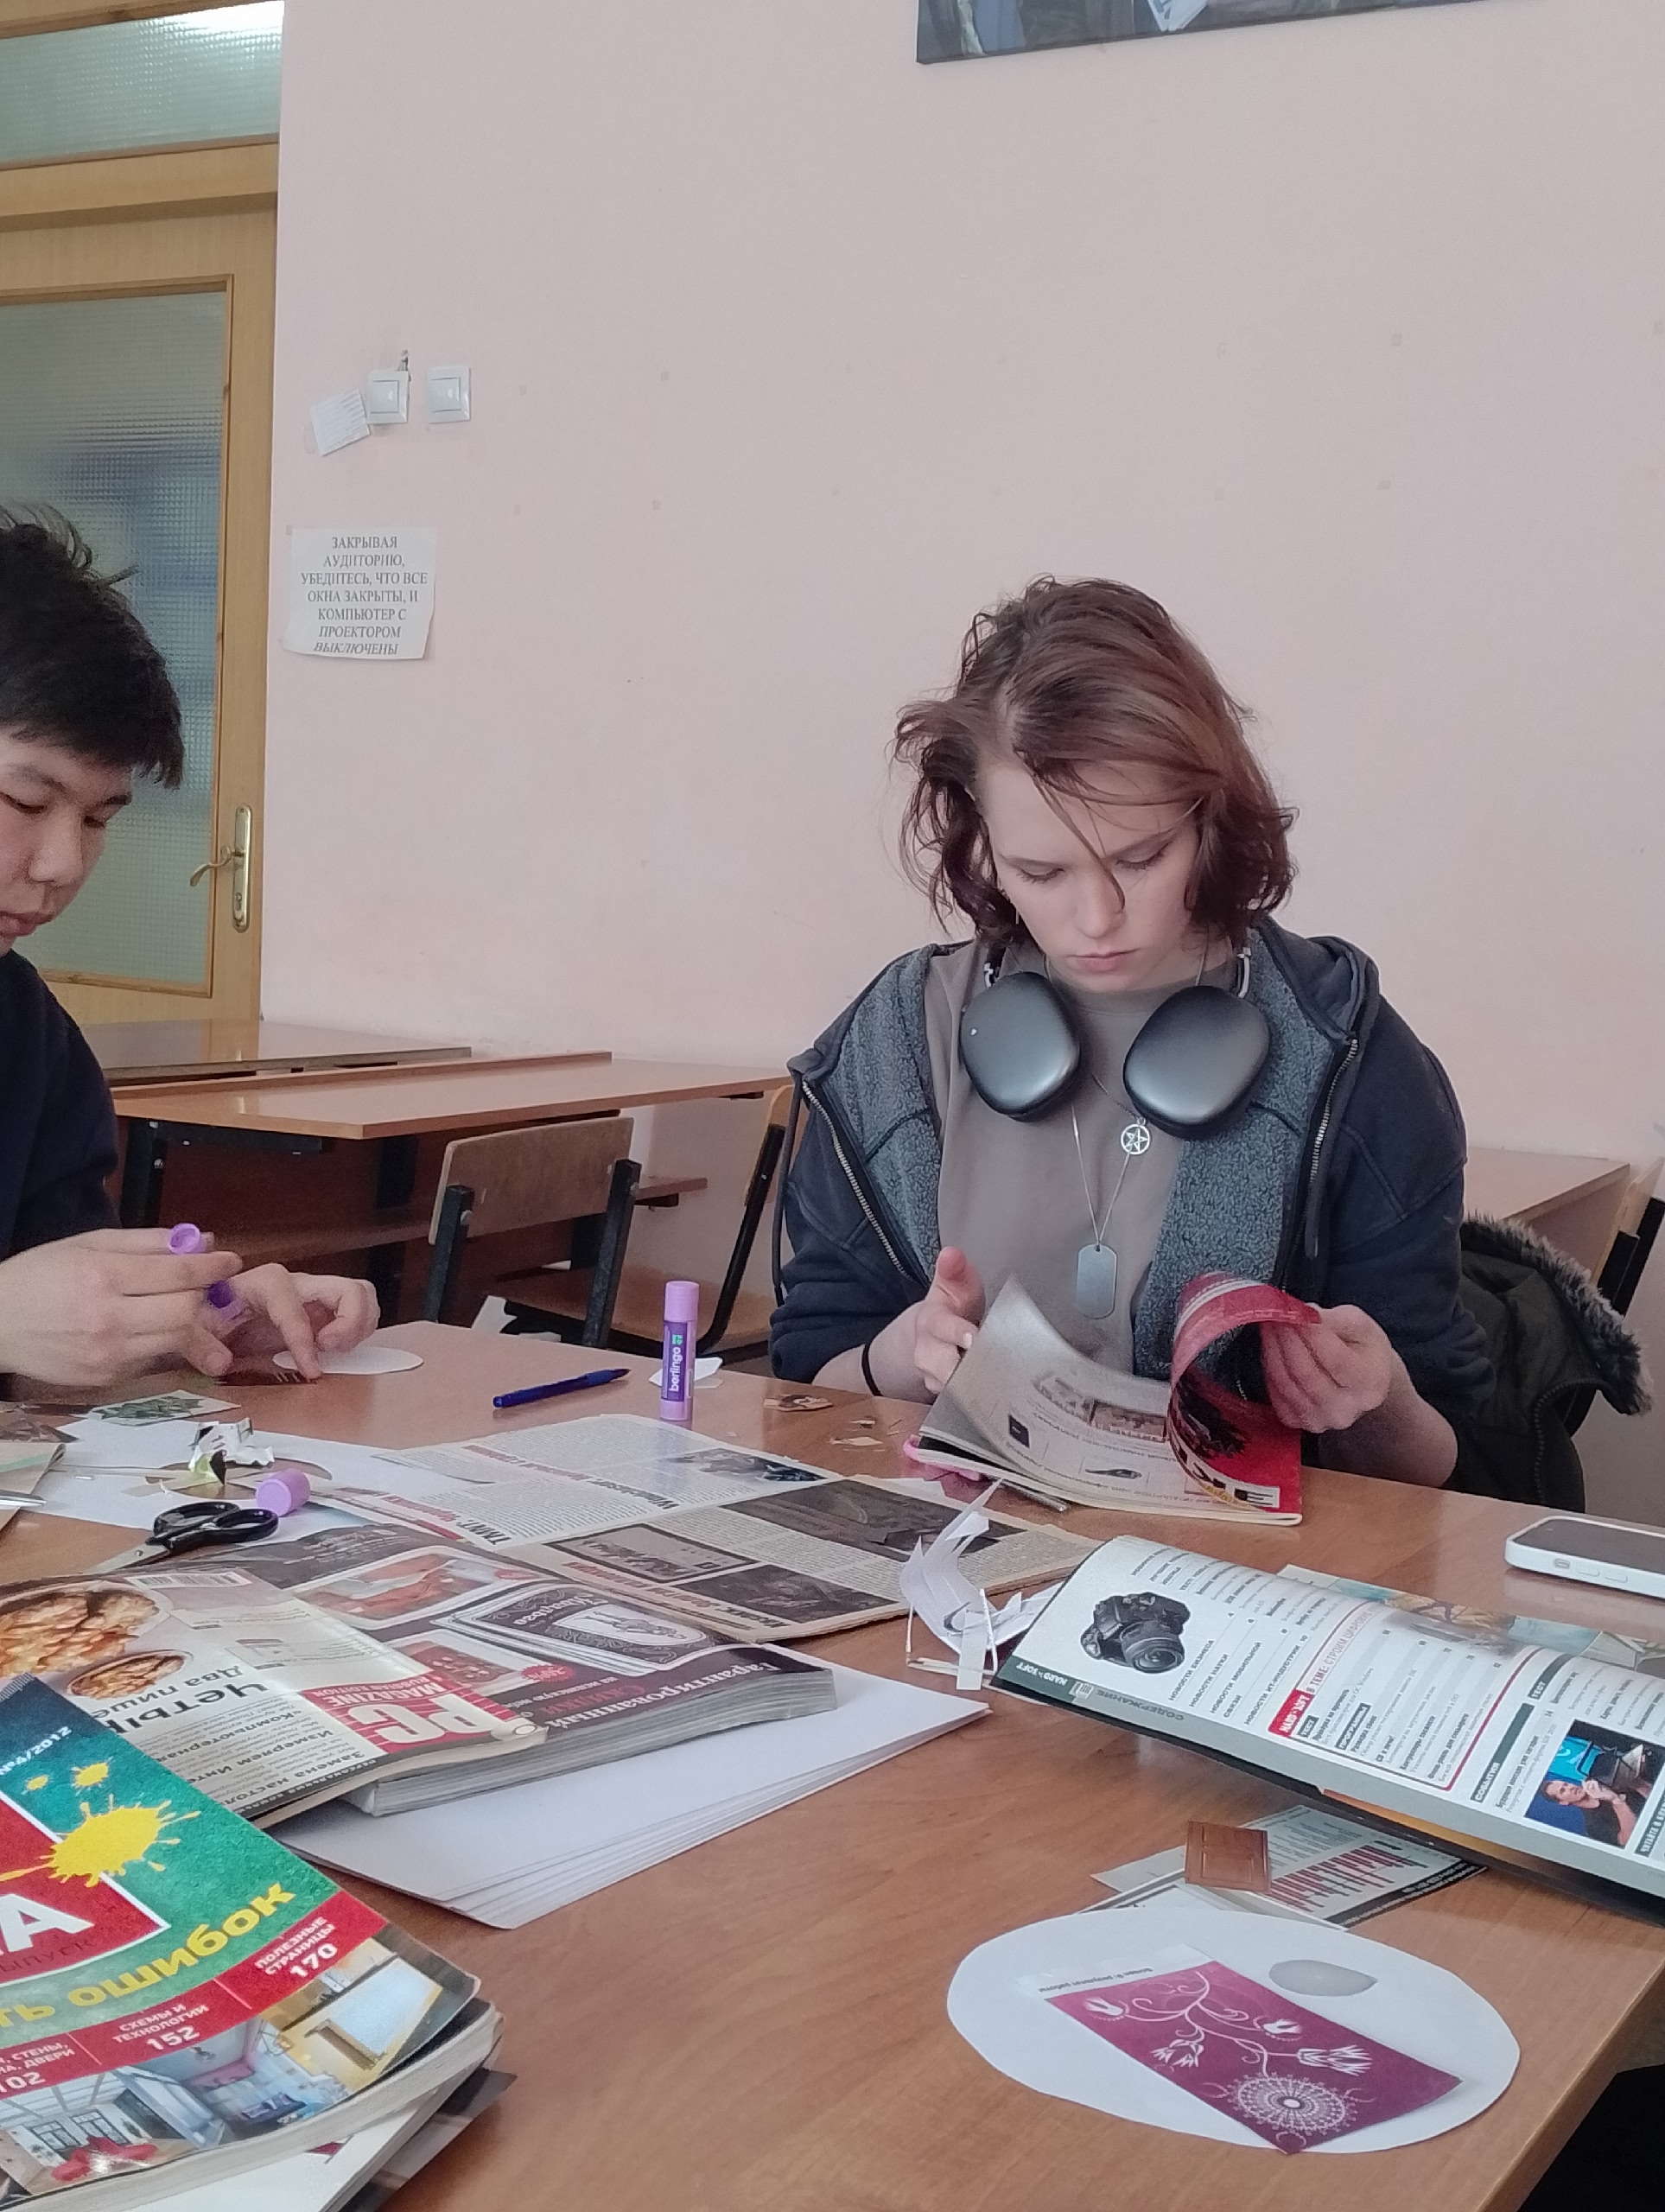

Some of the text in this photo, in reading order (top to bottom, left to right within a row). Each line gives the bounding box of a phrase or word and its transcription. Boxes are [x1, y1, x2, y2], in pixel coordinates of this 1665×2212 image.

[332, 537, 397, 549] ЗАКРЫВАЯ
[323, 555, 405, 568] АУДИТОРИЮ,
[301, 572, 428, 586] УБЕДИТЕСЬ, ЧТО ВСЕ
[307, 590, 418, 604] ОКНА ЗАКРЫТЫ, И
[318, 608, 406, 620] КОМПЬЮТЕР С
[319, 626, 402, 639] ПРОЕКТОРОМ
[314, 642, 398, 655] ВЫКЛЮЧЕНЫ
[669, 1346, 683, 1393] berlingo
[184, 1665, 244, 1687] Два
[1168, 1669, 1194, 1700] НОВОСТИ
[1192, 1640, 1215, 1669] БИЗНЕСА
[1189, 1675, 1214, 1707] НОВОСТИ
[1211, 1653, 1230, 1676] НАУКИ
[1210, 1641, 1262, 1714] НОВОСТИ МОБИЛЬНОЙ
[1310, 1664, 1330, 1686] ТЕМЕ:
[315, 1684, 371, 1697] EDITION
[323, 1684, 448, 1707] MAGAZINE
[544, 1661, 783, 1729] Гарантированный
[1244, 1694, 1269, 1726] НОВОСТИ
[1267, 1645, 1300, 1694] ИТ-ИНДУСТРИИ
[1532, 1681, 1547, 1700] ТЕСТ
[1095, 1688, 1185, 1721] СОДЕРЖАНИЕ
[1223, 1694, 1243, 1719] СВЯЗИ
[348, 1694, 501, 1744] PC
[156, 1710, 302, 1763] «Компьютерная
[237, 1730, 334, 1765] Измеряем
[295, 1752, 365, 1777] Замена
[1472, 1761, 1502, 1801] СОБЫТИЯ
[67, 1883, 296, 2007] ошибок
[254, 1916, 327, 1968] ПОЛЕЗНЫЕ
[264, 1923, 335, 1975] СТРАНИЦЫ
[289, 1943, 338, 1977] 170
[112, 2005, 209, 2044] ТЕХНОЛОГИИ
[119, 2003, 187, 2031] СХЕМЫ И
[146, 2025, 200, 2050] 152
[24, 2049, 75, 2069] ДВЕРИ
